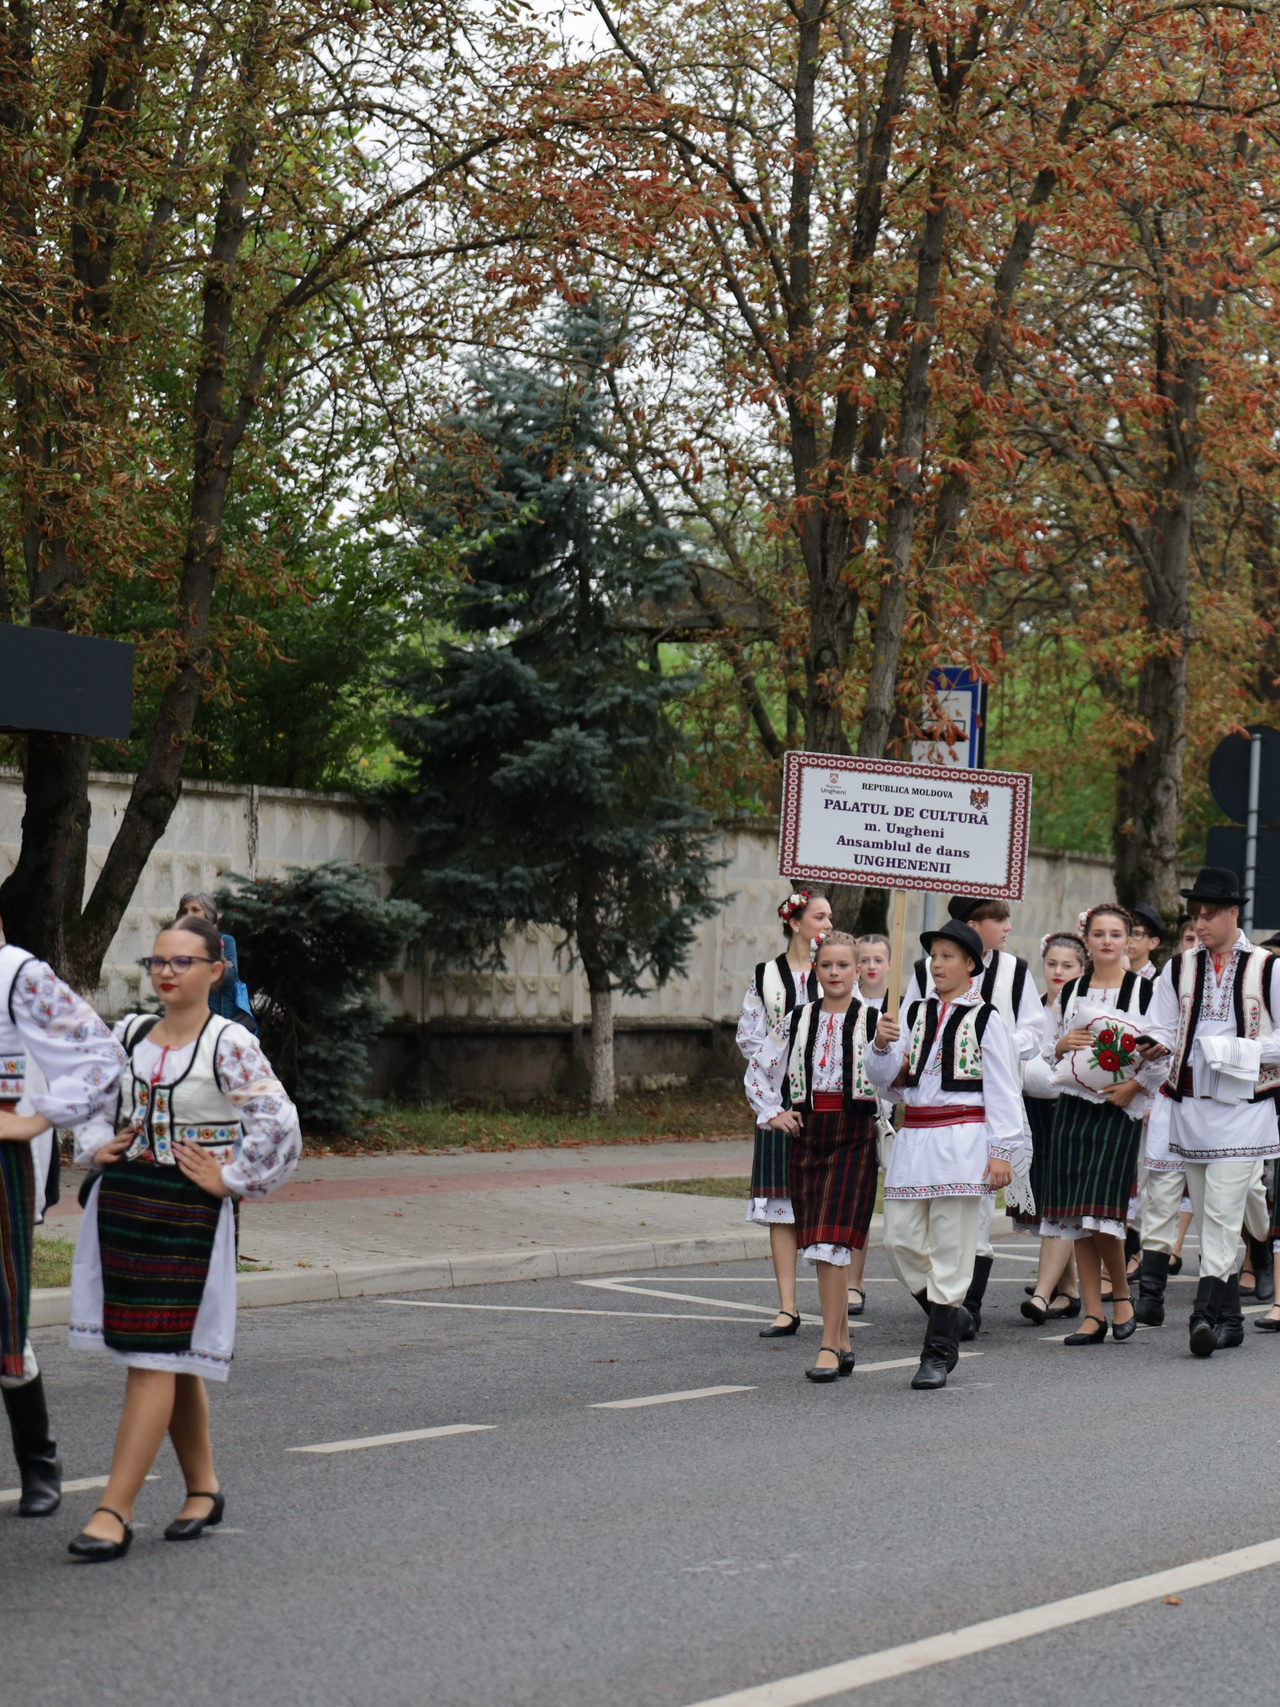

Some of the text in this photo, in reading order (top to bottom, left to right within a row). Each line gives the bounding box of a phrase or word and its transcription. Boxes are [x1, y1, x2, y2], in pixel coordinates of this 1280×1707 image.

[820, 787, 847, 795] Ungheni
[861, 782, 954, 799] REPUBLICA MOLDOVA
[823, 798, 989, 826] PALATUL DE CULTURĂ
[864, 822, 945, 839] m. Ungheni
[836, 834, 970, 859] Ansamblul de dans
[853, 853, 951, 874] UNGHENENII
